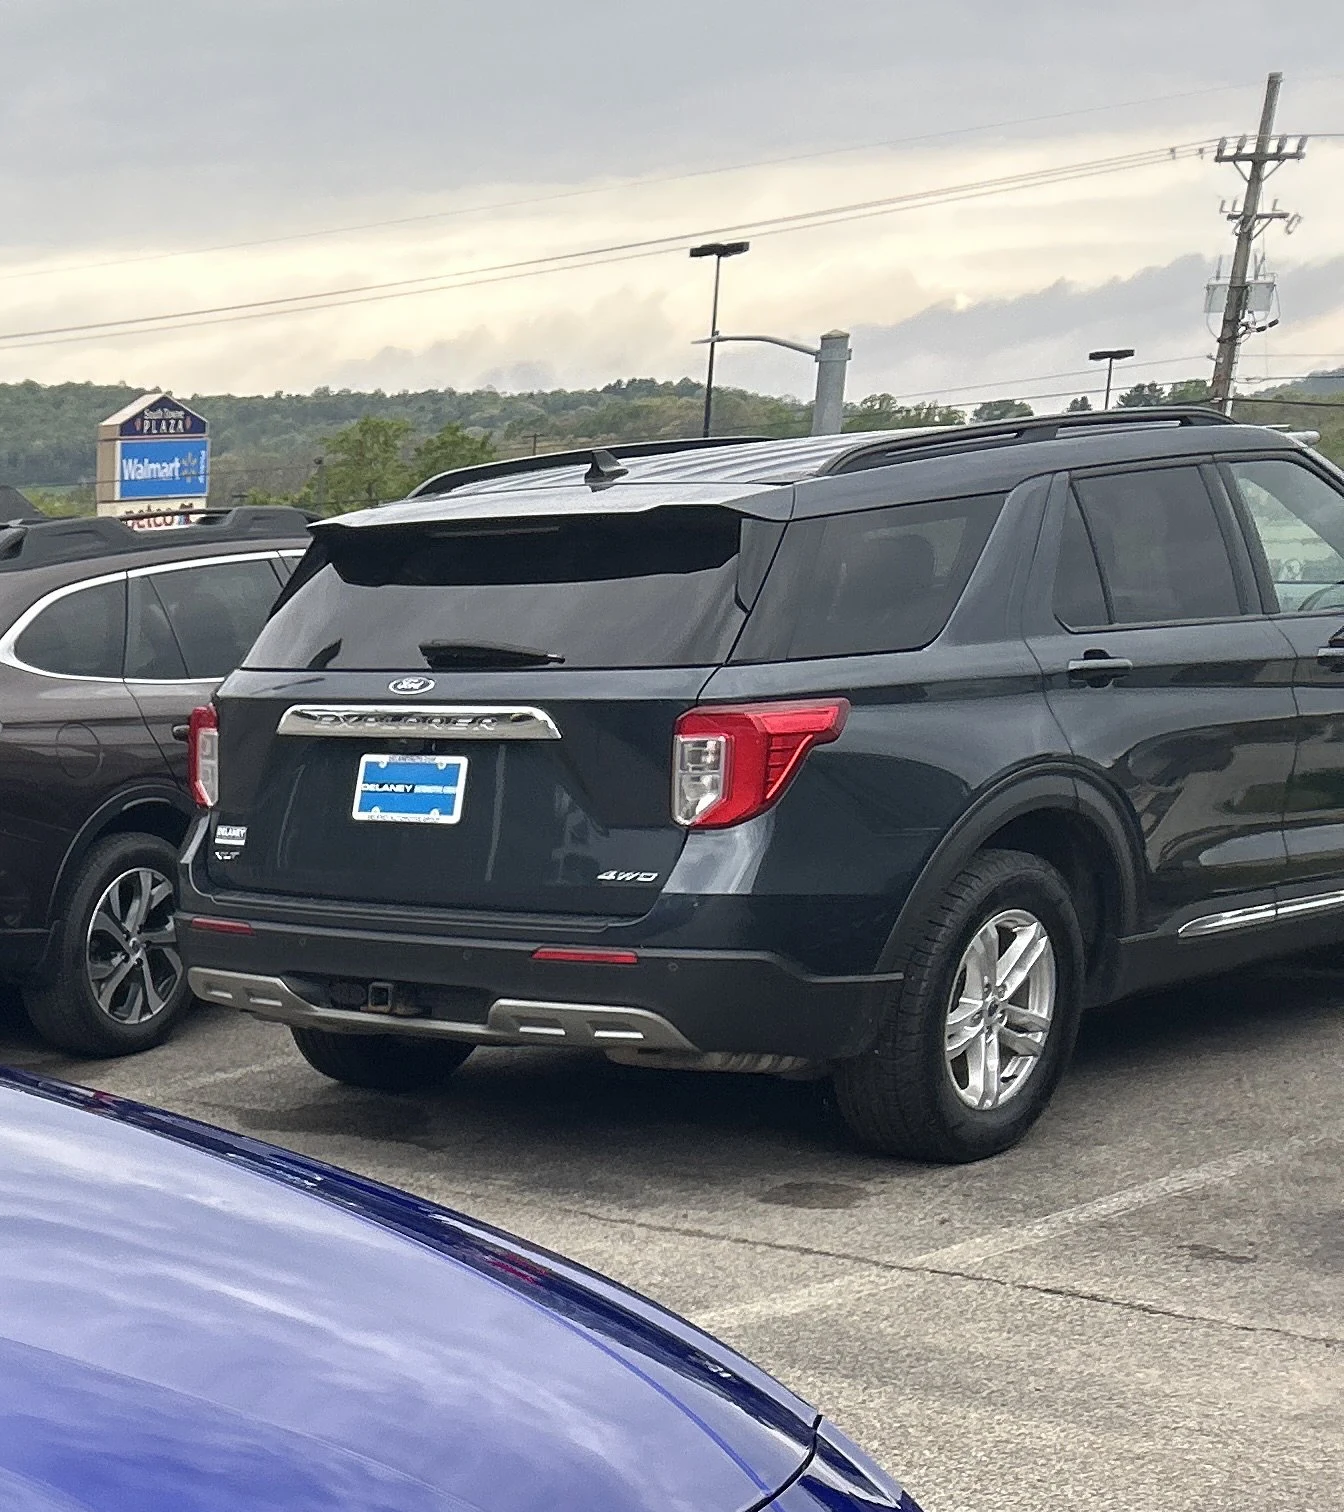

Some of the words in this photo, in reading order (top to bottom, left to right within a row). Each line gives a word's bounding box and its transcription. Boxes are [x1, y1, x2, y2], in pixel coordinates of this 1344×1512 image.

[143, 419, 184, 433] PLAZA
[122, 456, 180, 481] Walmart
[314, 713, 498, 732] EXPLORER
[361, 783, 413, 793] DELANEY
[596, 869, 660, 883] 4WD
